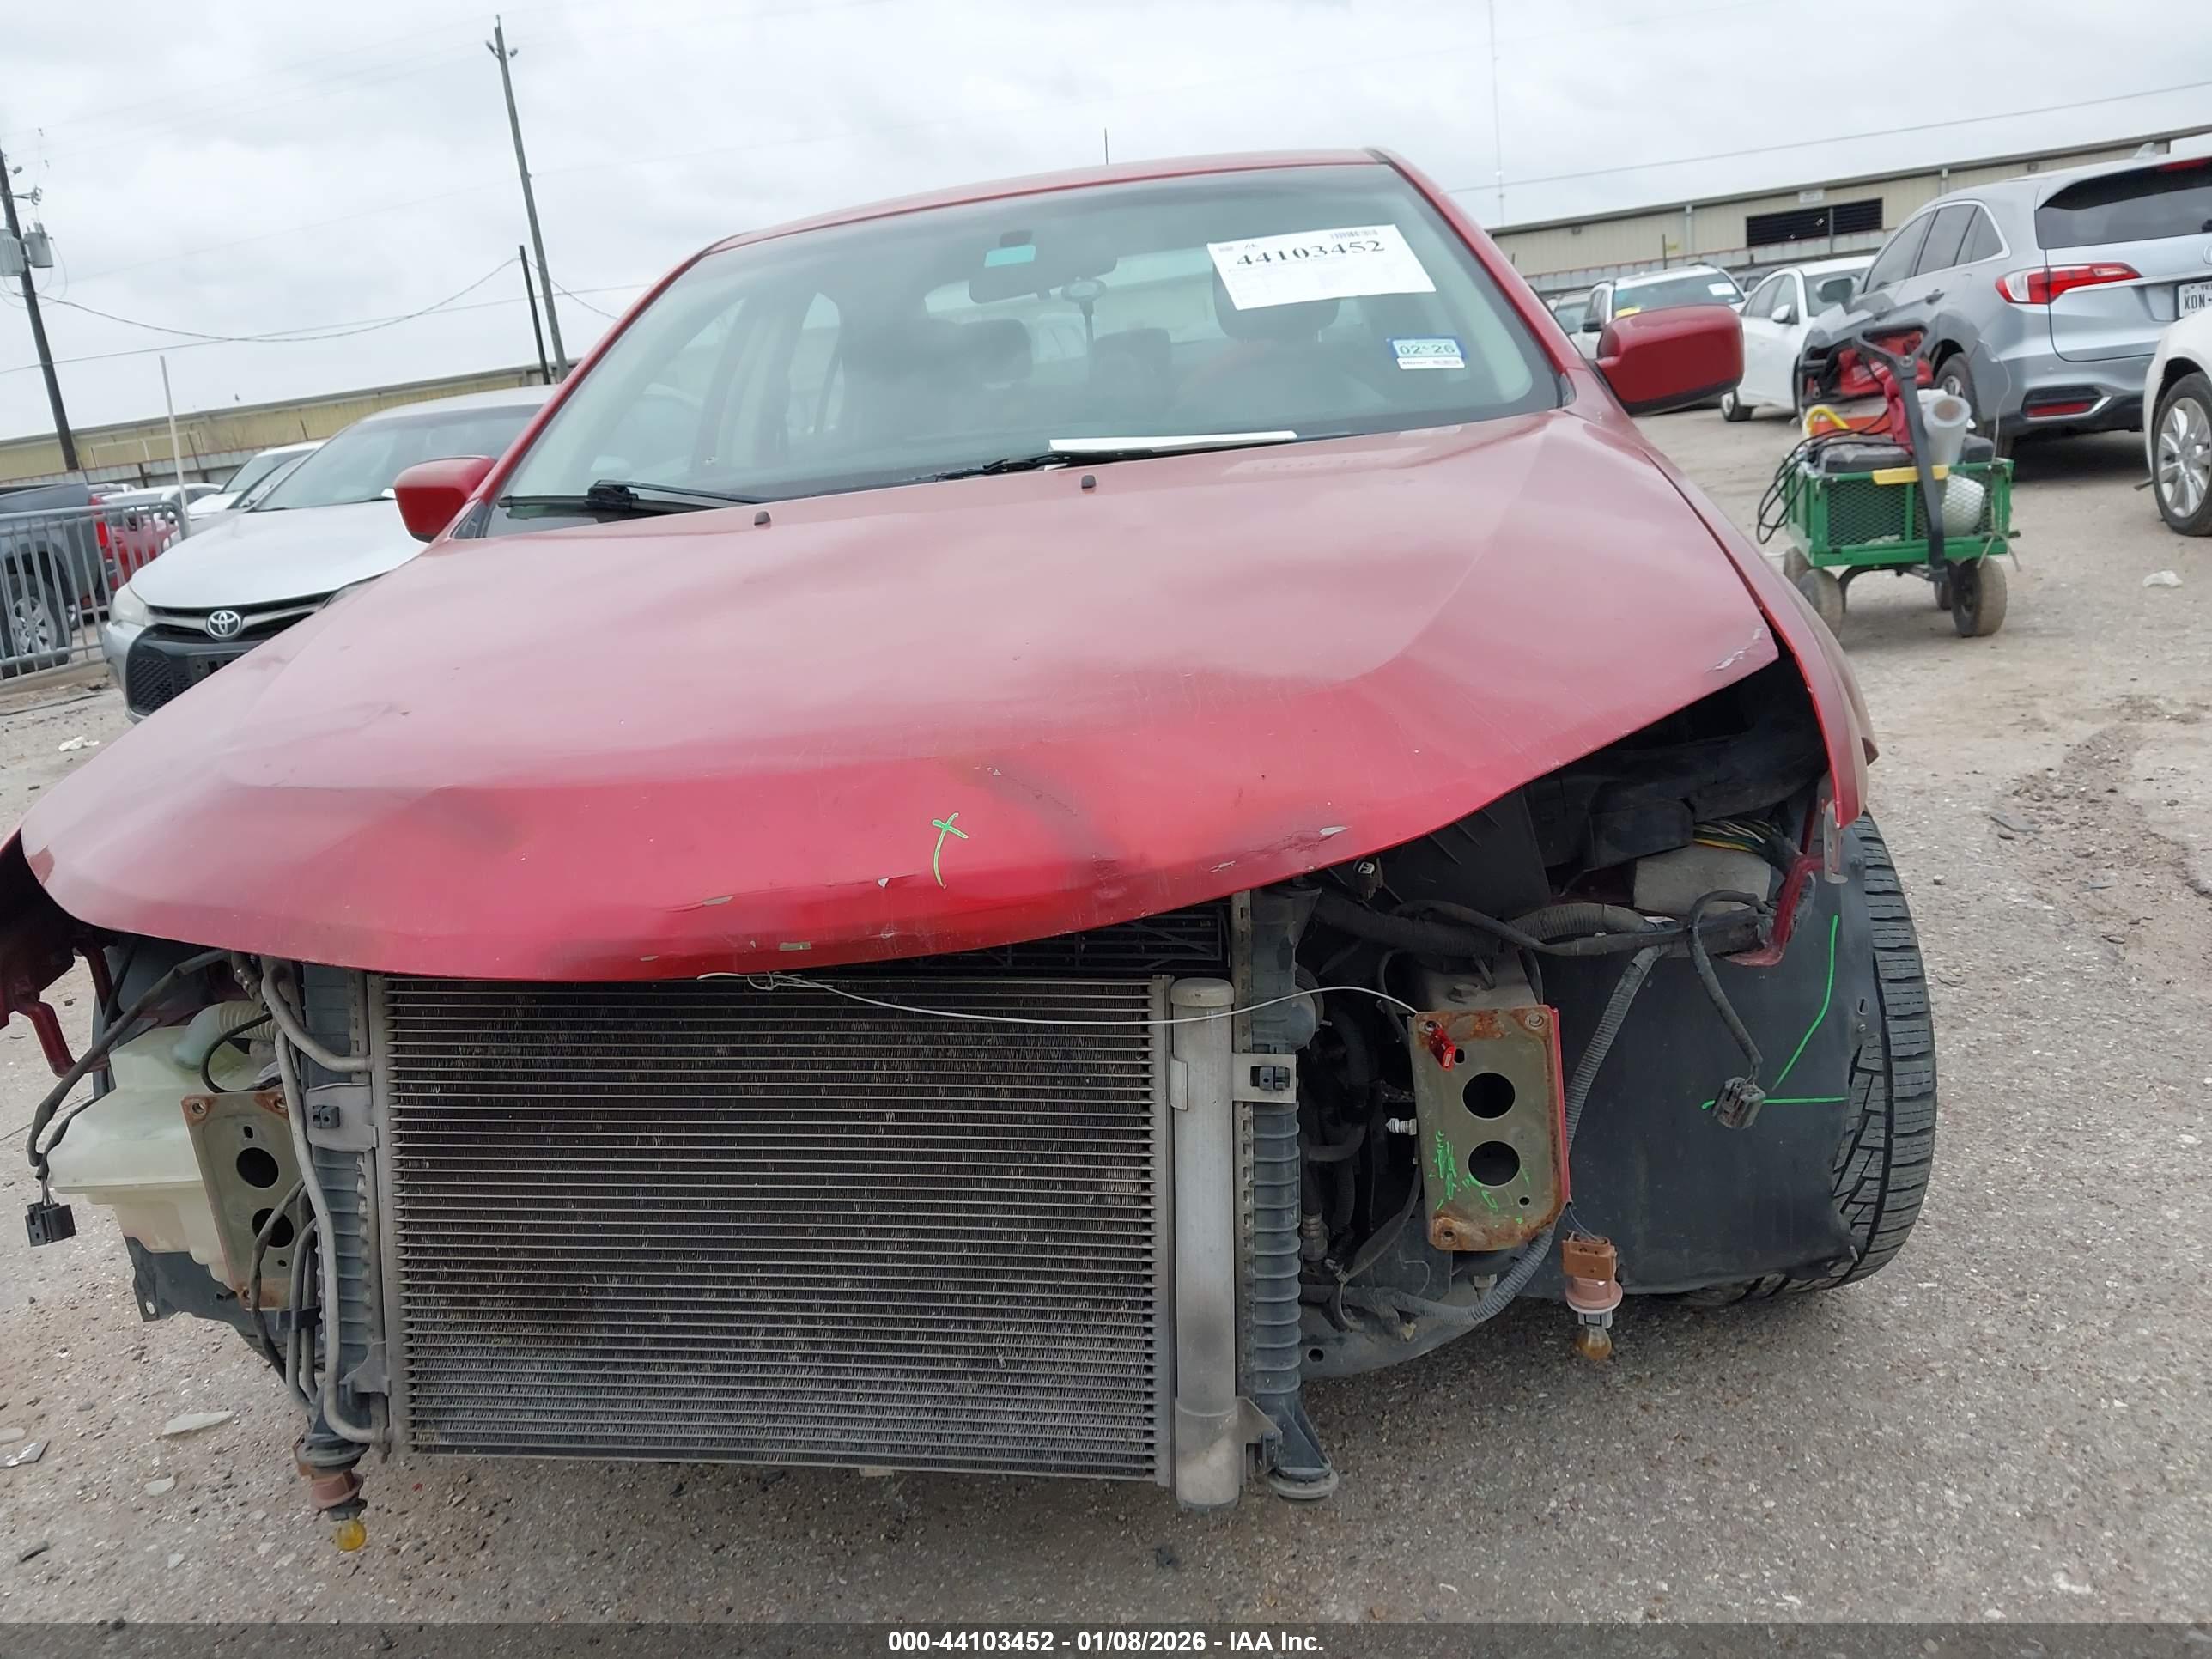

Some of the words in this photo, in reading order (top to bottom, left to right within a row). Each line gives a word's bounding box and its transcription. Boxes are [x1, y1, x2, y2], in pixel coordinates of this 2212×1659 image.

[1237, 240, 1385, 265] 44103452
[1400, 345, 1422, 355] 02
[1431, 344, 1455, 354] 26
